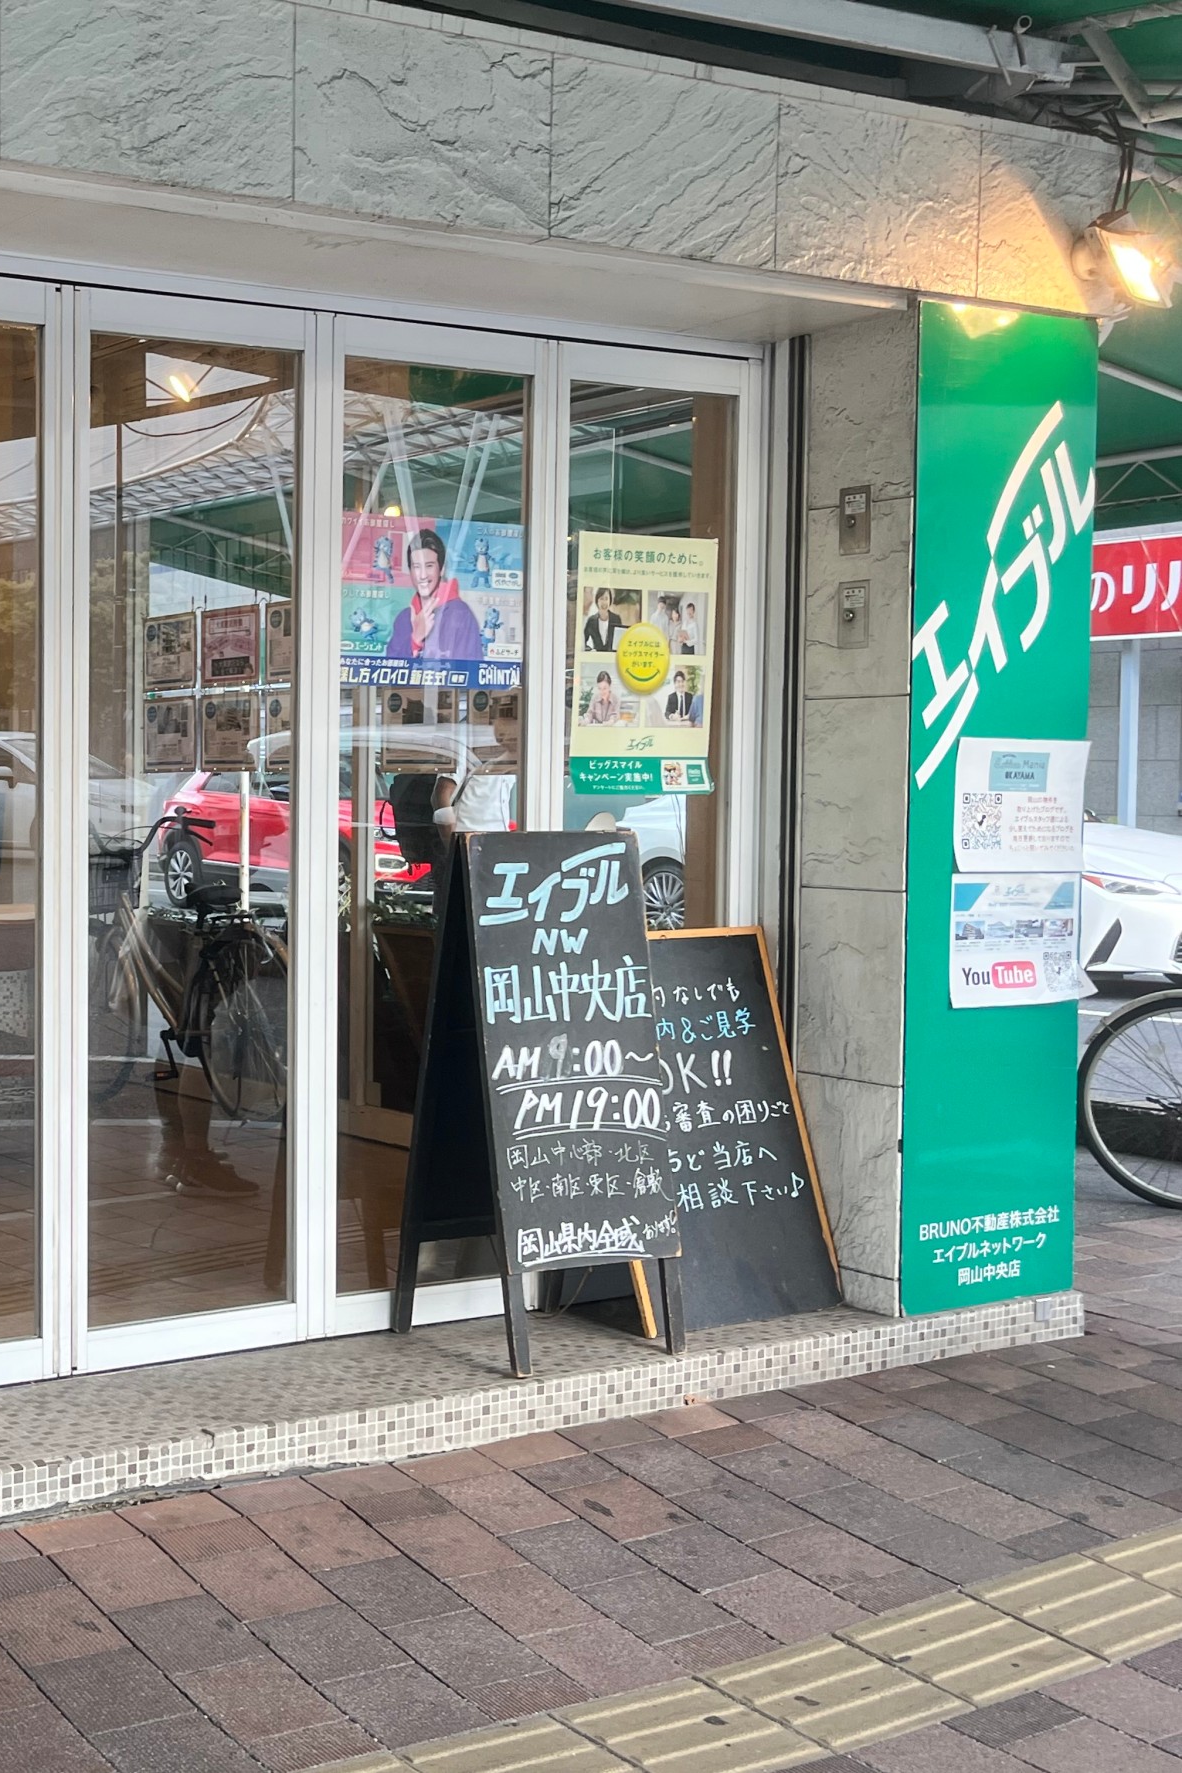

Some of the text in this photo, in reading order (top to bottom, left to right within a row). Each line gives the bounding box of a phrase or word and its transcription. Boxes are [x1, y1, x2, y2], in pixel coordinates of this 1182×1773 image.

[593, 548, 704, 566] お客様の笑顔のために。
[912, 400, 1095, 790] エイブル
[622, 649, 665, 659] ビッグスマイラー
[627, 640, 661, 648] エイブルには
[478, 666, 521, 686] CHINTAI
[579, 772, 654, 783] キャンペーン実施中!
[588, 760, 643, 770] ビッグスマイル
[1005, 771, 1035, 780] OKAYAMA
[479, 842, 628, 927] エイブル
[531, 928, 588, 956] NW
[484, 955, 652, 1025] 岡山中央店
[919, 1204, 1060, 1241] BRUNO不動産株式会社
[517, 1215, 646, 1263] 岡山県内全域
[932, 1231, 1047, 1264] エイブルネットワーク
[957, 1259, 1021, 1286] 岡山中央店
